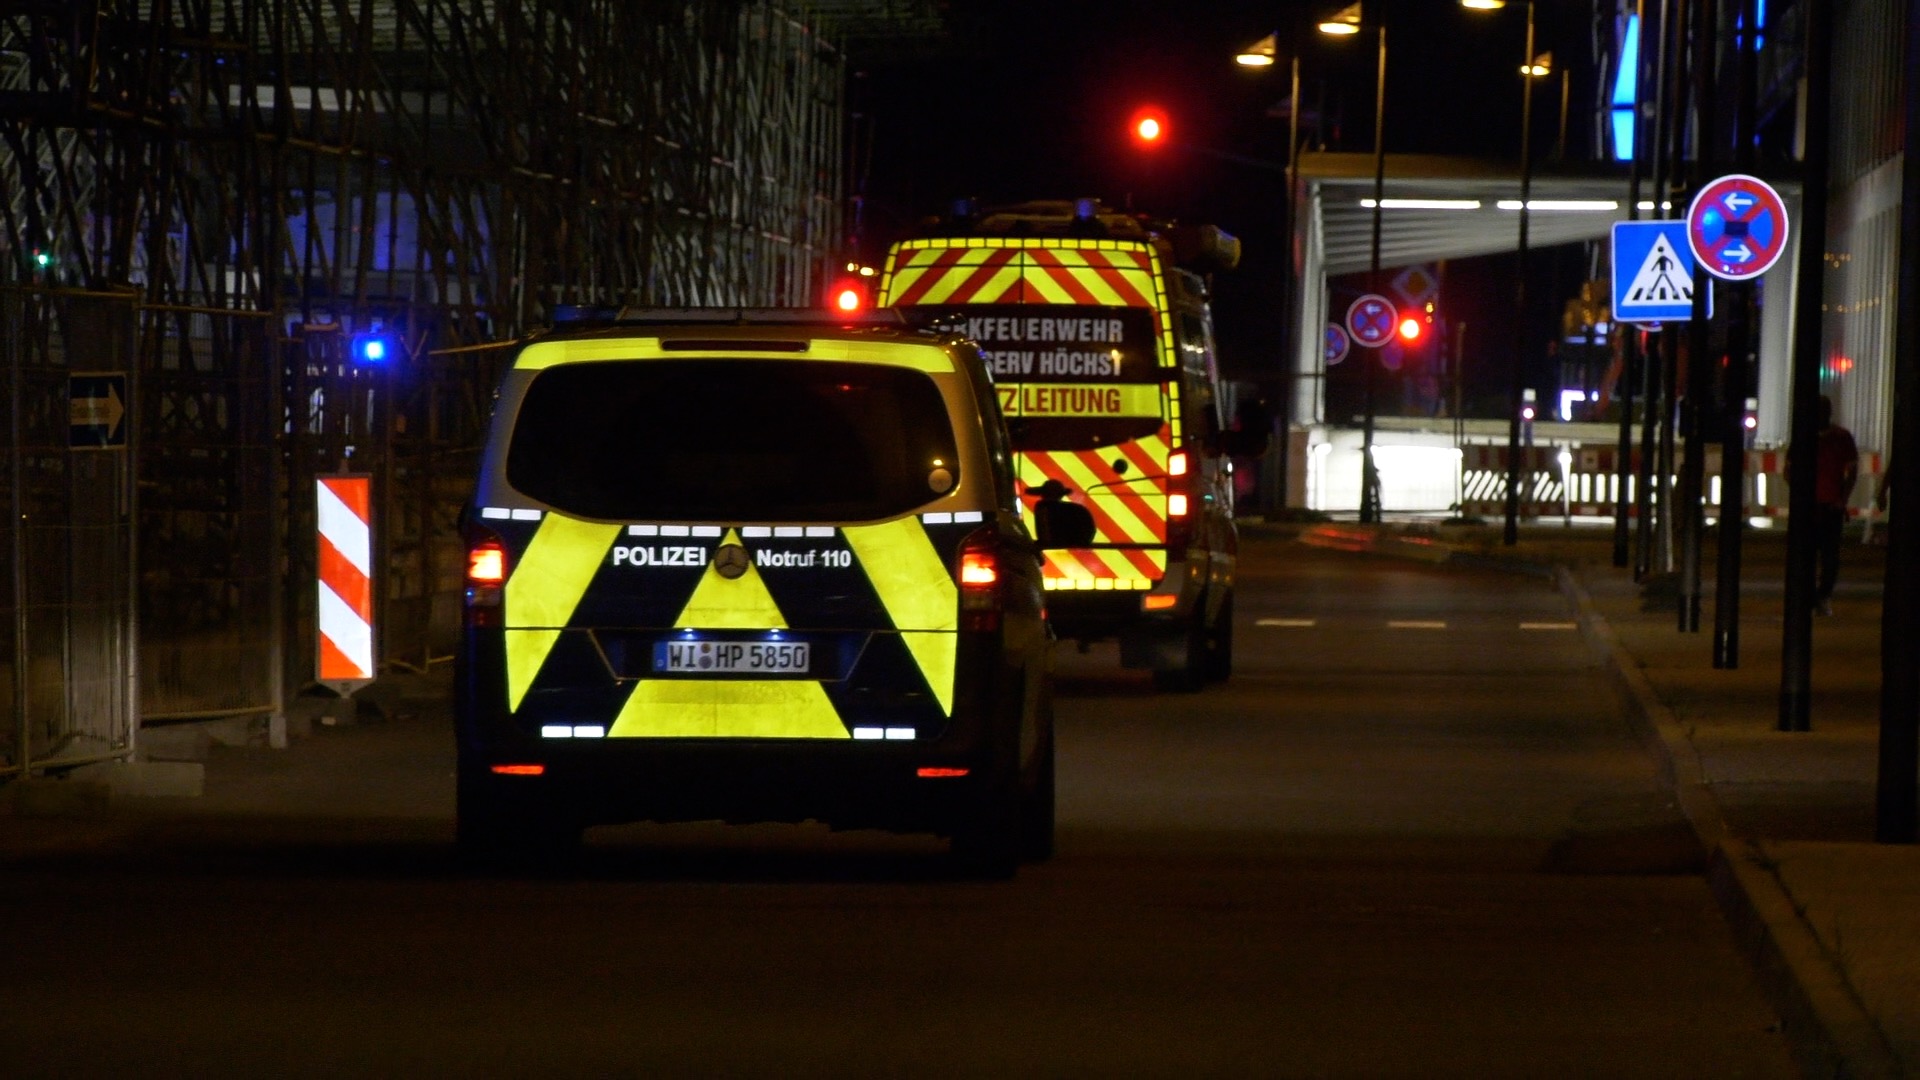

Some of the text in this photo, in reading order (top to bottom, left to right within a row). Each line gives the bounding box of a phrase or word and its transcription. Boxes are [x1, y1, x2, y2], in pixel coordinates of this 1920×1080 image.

[613, 546, 707, 566] POLIZEI
[756, 548, 852, 567] Notruf 110
[669, 644, 696, 667] WI
[715, 645, 744, 668] HP
[750, 645, 806, 669] 5850
